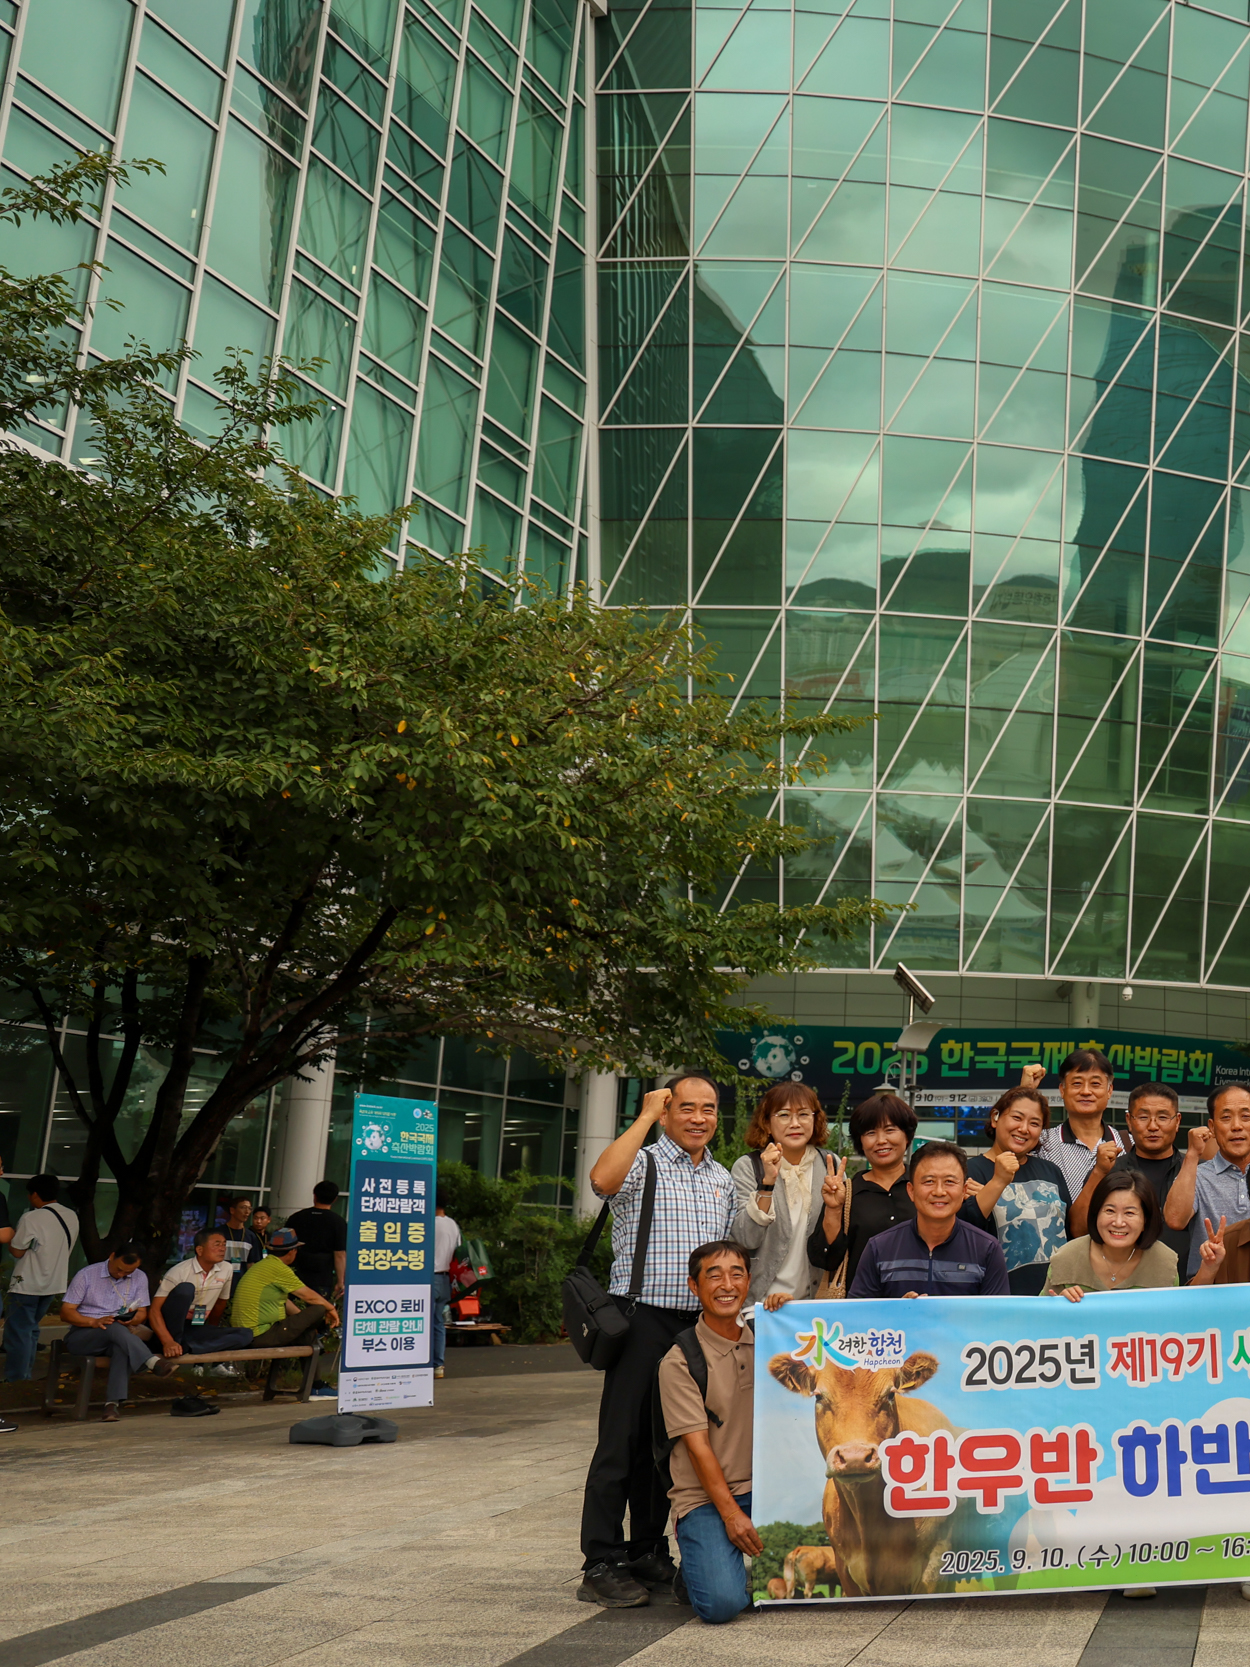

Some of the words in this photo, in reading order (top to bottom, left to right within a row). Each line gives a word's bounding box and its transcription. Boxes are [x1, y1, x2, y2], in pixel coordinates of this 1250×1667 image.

[940, 1039, 1213, 1086] 한국국제산박람회
[1215, 1065, 1238, 1076] Korea
[415, 1123, 434, 1132] 2025
[400, 1131, 435, 1144] 한국국제
[391, 1142, 434, 1155] 축산박람회
[361, 1196, 425, 1214] 단체관람객
[358, 1248, 425, 1271] 현장수령
[355, 1299, 397, 1314] EXCO
[400, 1299, 424, 1313] 로비
[355, 1321, 377, 1334] 단체
[379, 1320, 400, 1333] 관람
[402, 1320, 423, 1332] 안내
[362, 1338, 387, 1353] 부스
[390, 1336, 415, 1351] 이용
[868, 1332, 903, 1357] 합천
[864, 1358, 901, 1369] Hapcheon
[965, 1339, 1096, 1387] 2025년
[1111, 1333, 1218, 1383] 제19기
[884, 1428, 1098, 1511] 한우반
[941, 1551, 1005, 1574] 2025.
[1012, 1549, 1032, 1570] 9.
[1040, 1547, 1069, 1568] 10.
[1077, 1544, 1122, 1570] (수)
[1129, 1540, 1189, 1563] 10:00
